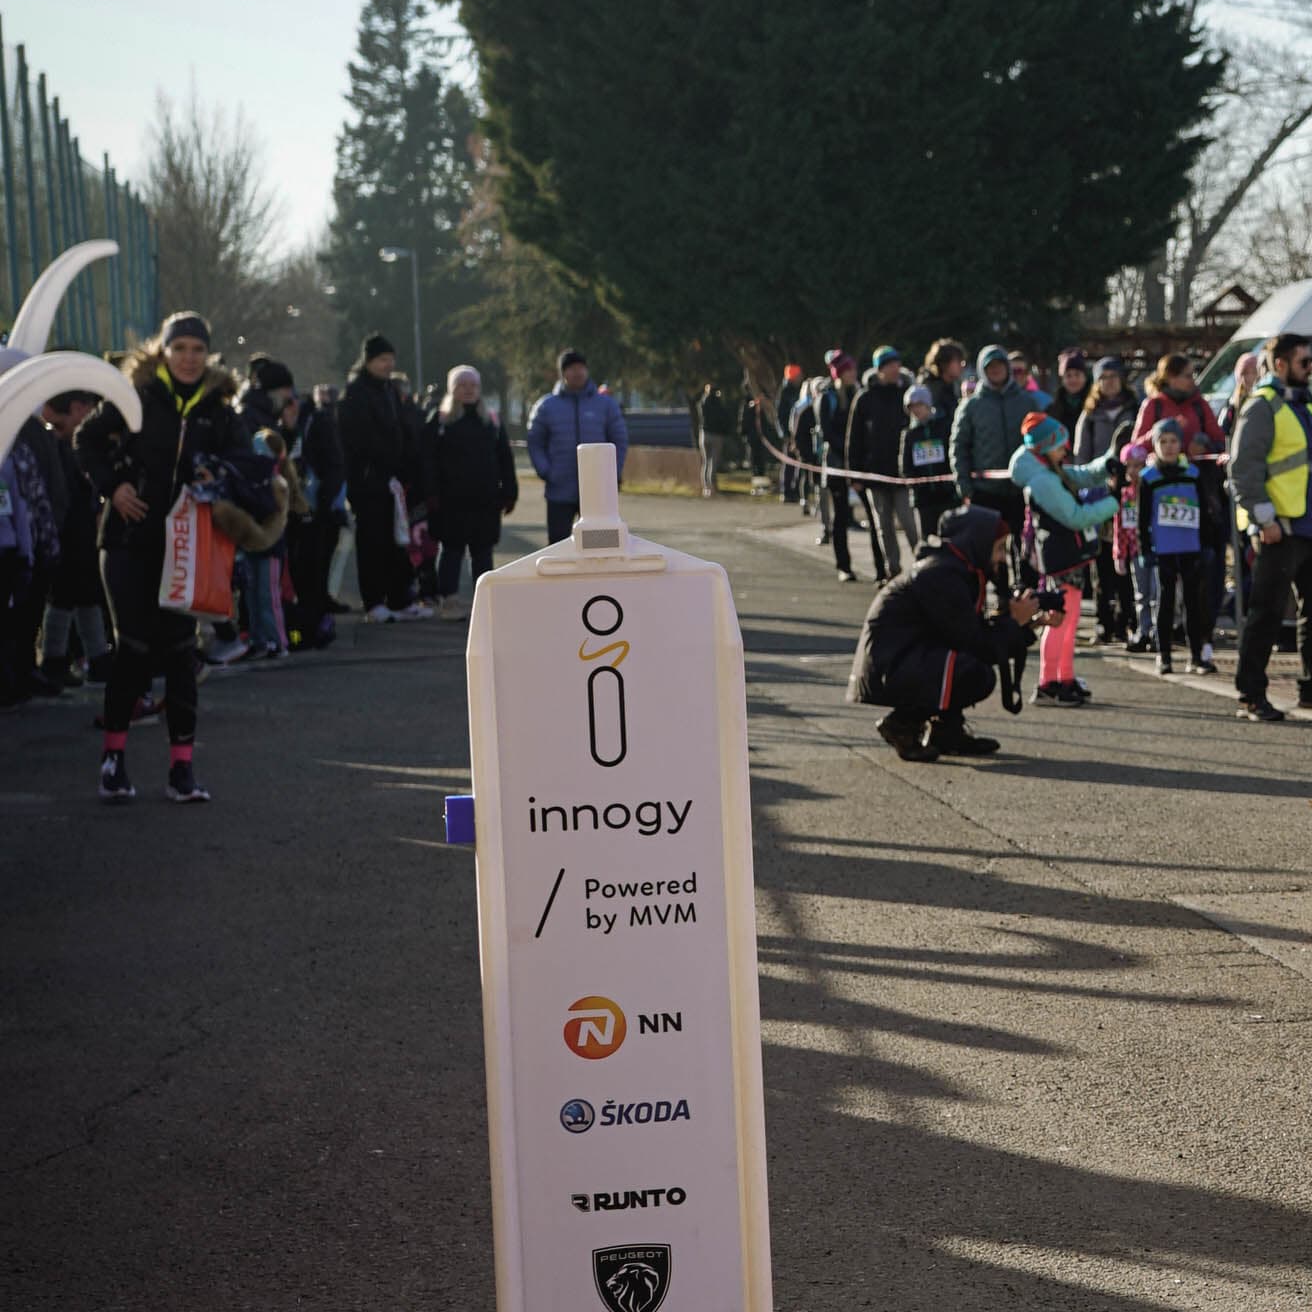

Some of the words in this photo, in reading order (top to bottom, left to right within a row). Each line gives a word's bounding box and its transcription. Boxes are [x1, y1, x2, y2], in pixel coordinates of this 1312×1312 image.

[529, 797, 693, 836] innogy
[586, 872, 697, 900] Powered
[586, 907, 617, 935] by
[630, 903, 697, 927] MVM
[638, 1011, 682, 1035] NN
[600, 1099, 691, 1127] ŠKODA
[593, 1187, 687, 1212] RUNTO
[600, 1250, 664, 1264] PEUGEOT
